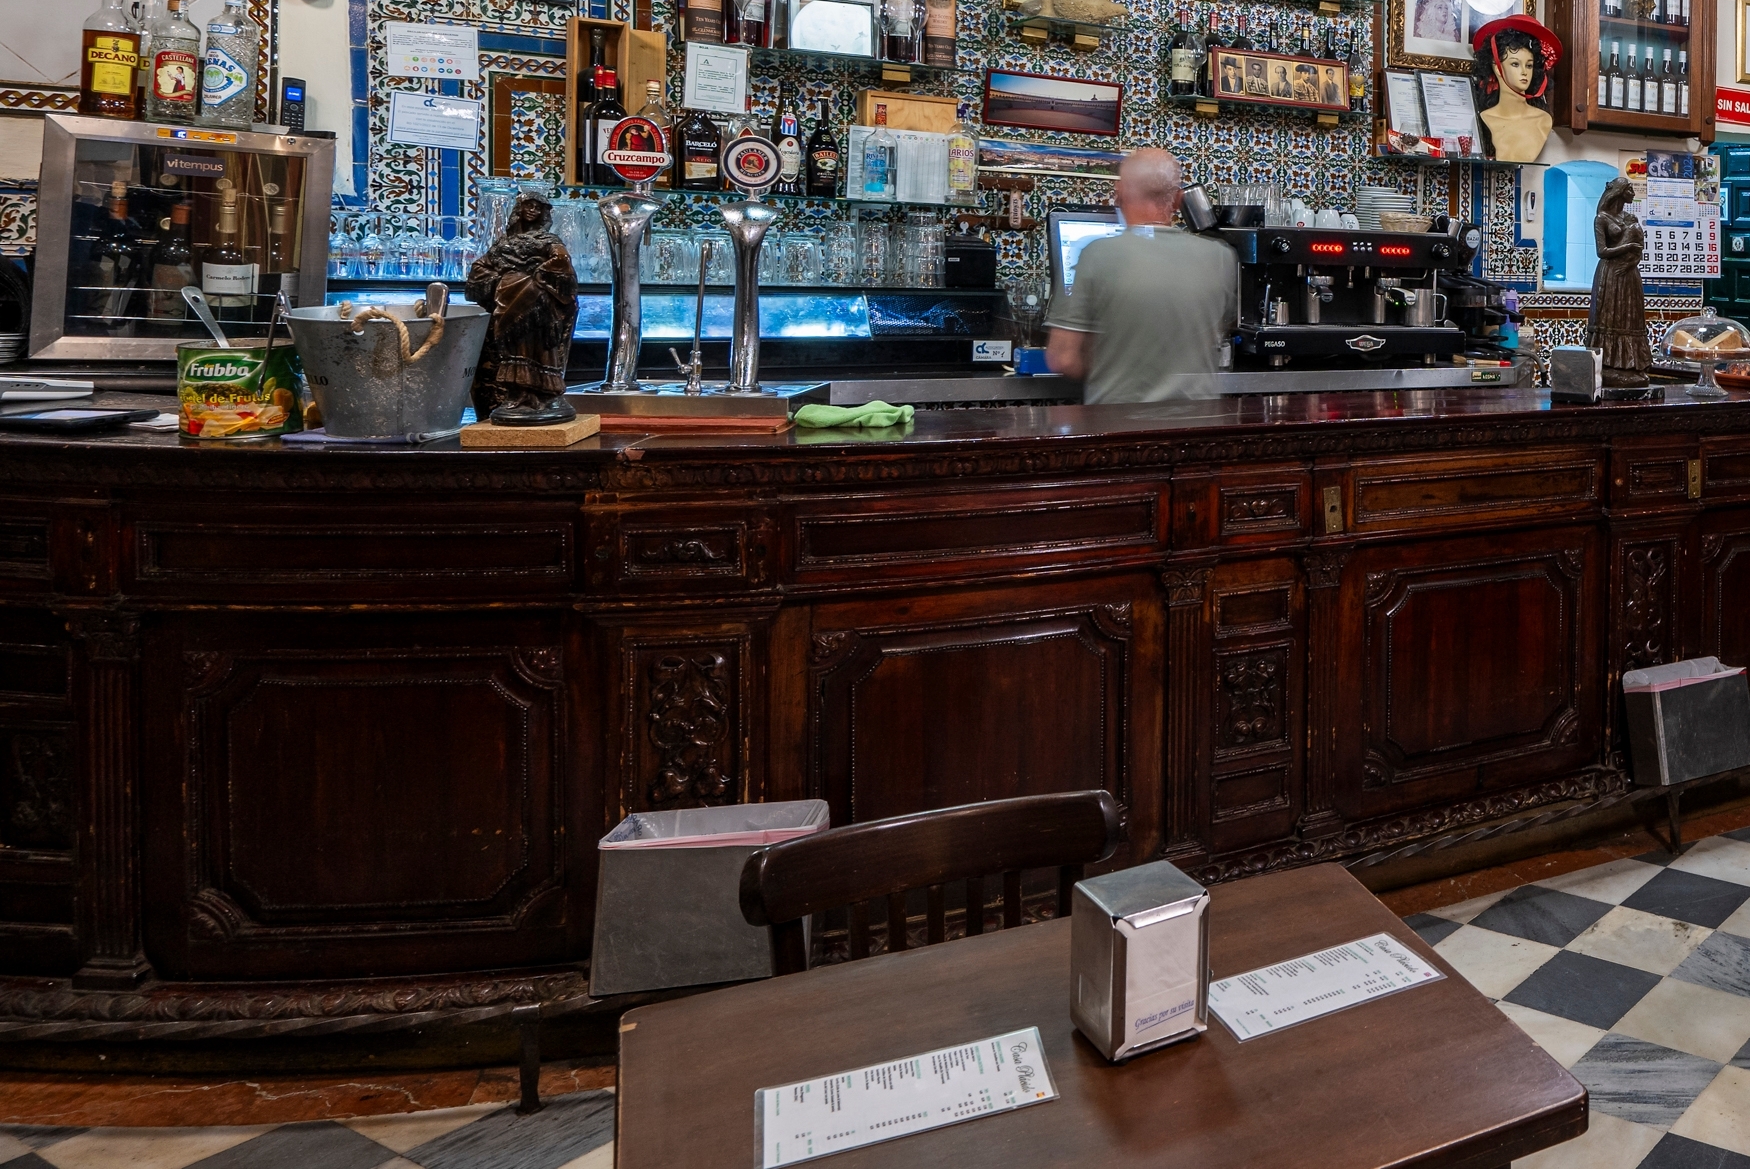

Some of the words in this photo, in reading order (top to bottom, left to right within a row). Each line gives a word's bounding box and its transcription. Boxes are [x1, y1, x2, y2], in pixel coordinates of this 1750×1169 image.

[91, 51, 136, 63] DECANO
[1717, 99, 1732, 111] SIN
[607, 153, 665, 164] Cruzcampo
[180, 161, 223, 172] tempus
[1264, 340, 1285, 348] PEGASO
[1135, 1014, 1157, 1030] Gracias
[1158, 1009, 1169, 1021] por
[1179, 1000, 1194, 1011] visita
